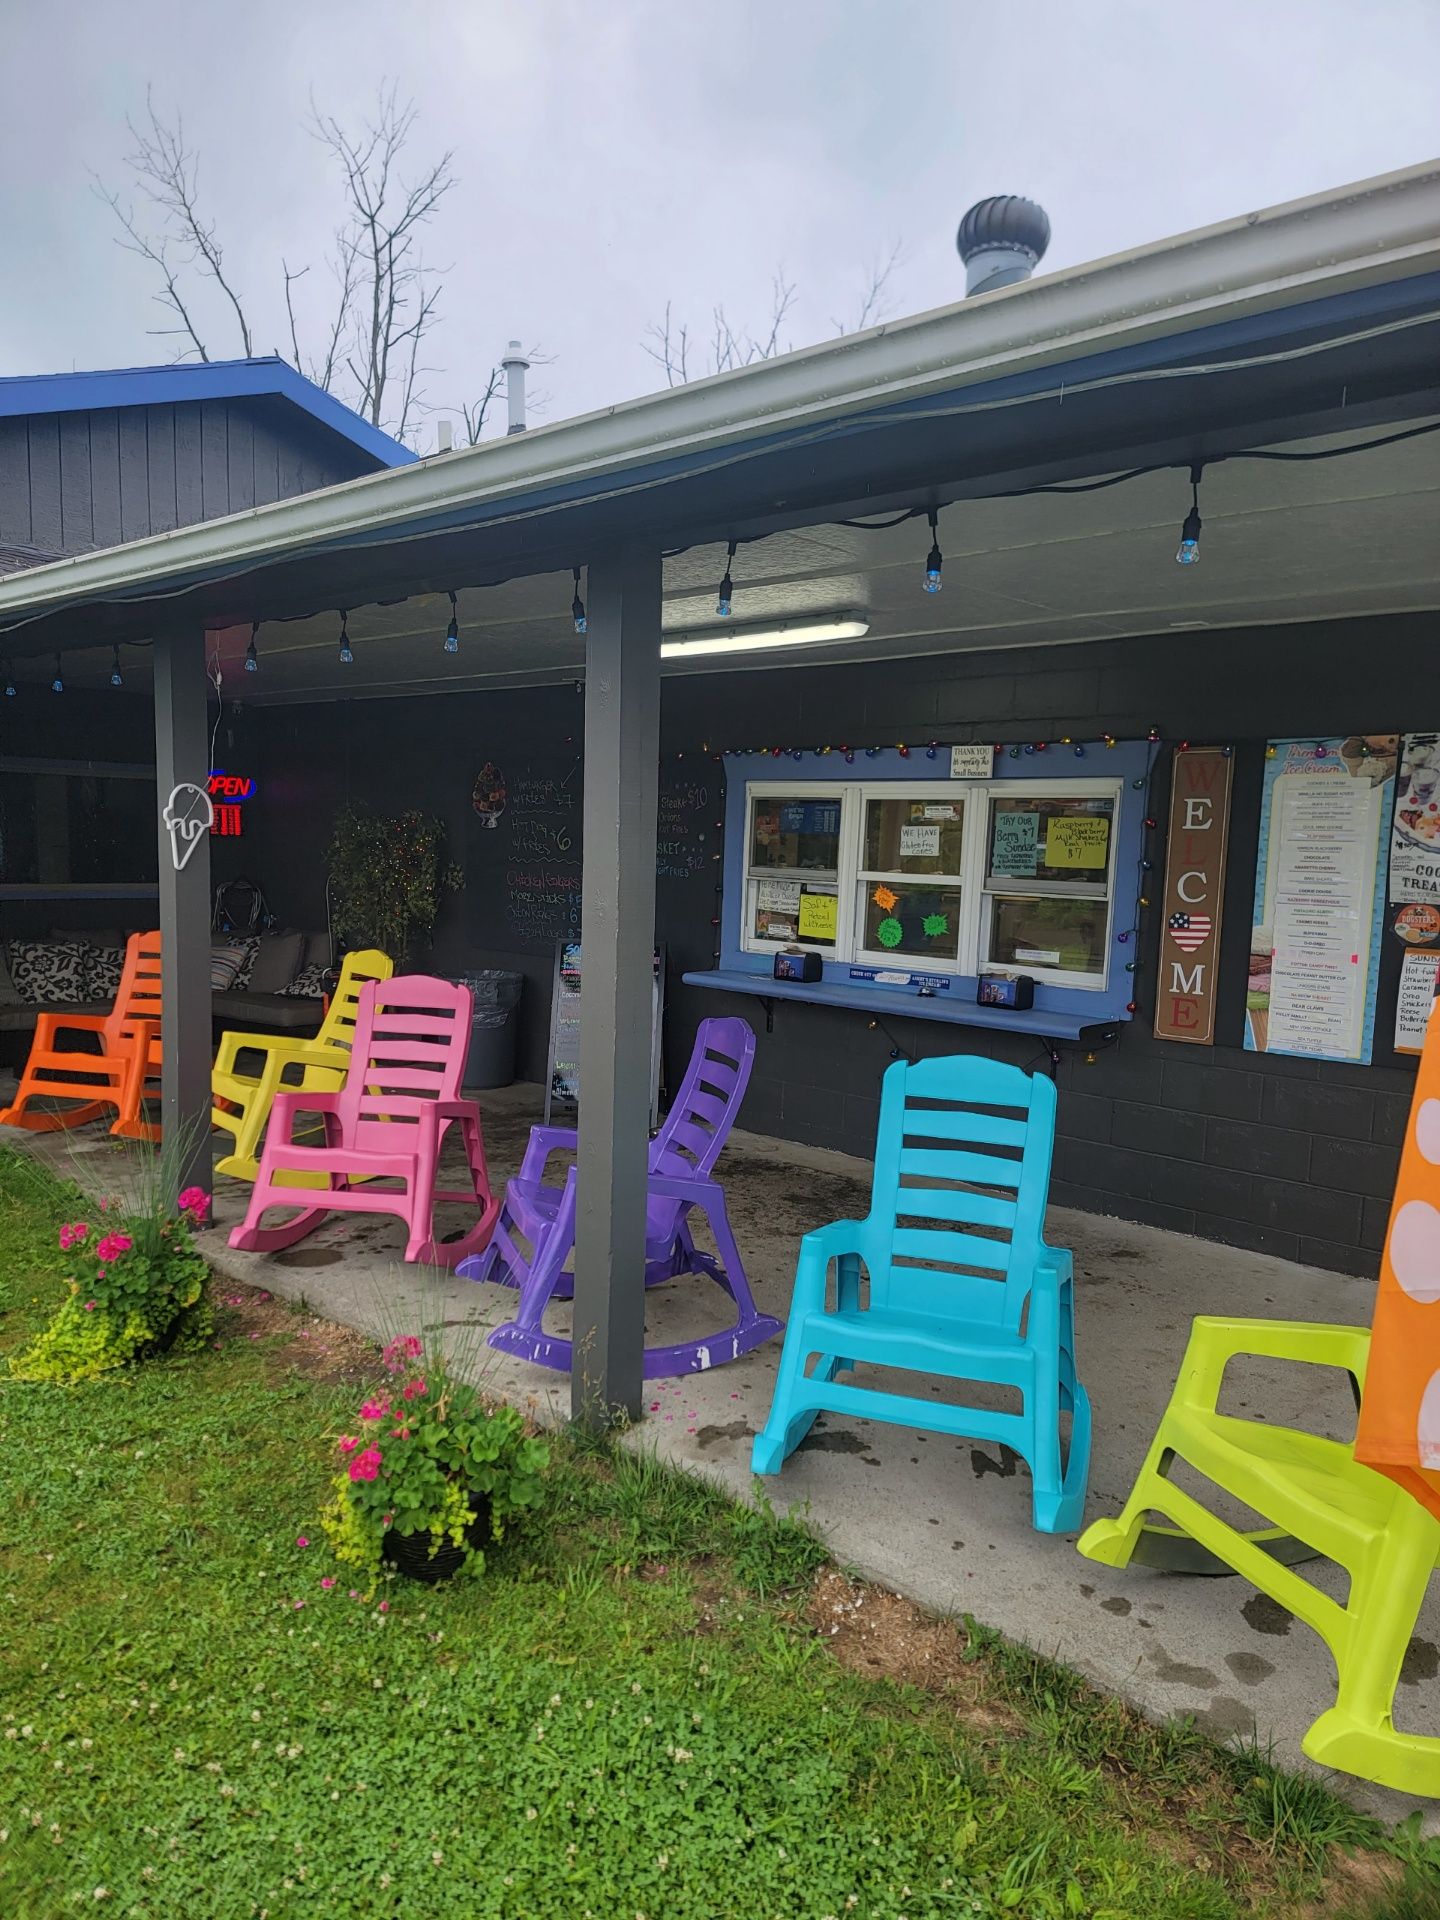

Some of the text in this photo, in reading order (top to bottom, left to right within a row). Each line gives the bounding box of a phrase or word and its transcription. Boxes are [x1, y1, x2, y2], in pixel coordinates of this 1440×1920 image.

[976, 747, 990, 755] YOU
[1304, 761, 1341, 774] Cream
[688, 786, 708, 810] $10
[1000, 815, 1033, 826] TRY OUR
[902, 828, 937, 838] WE HAVE
[997, 830, 1018, 843] Berry
[656, 840, 680, 855] SKET
[1402, 876, 1440, 892] TREA
[1402, 914, 1435, 925] DOGSTERS
[1405, 966, 1418, 974] Hot
[1402, 984, 1431, 992] Caramel
[1399, 1024, 1422, 1033] Peanut
